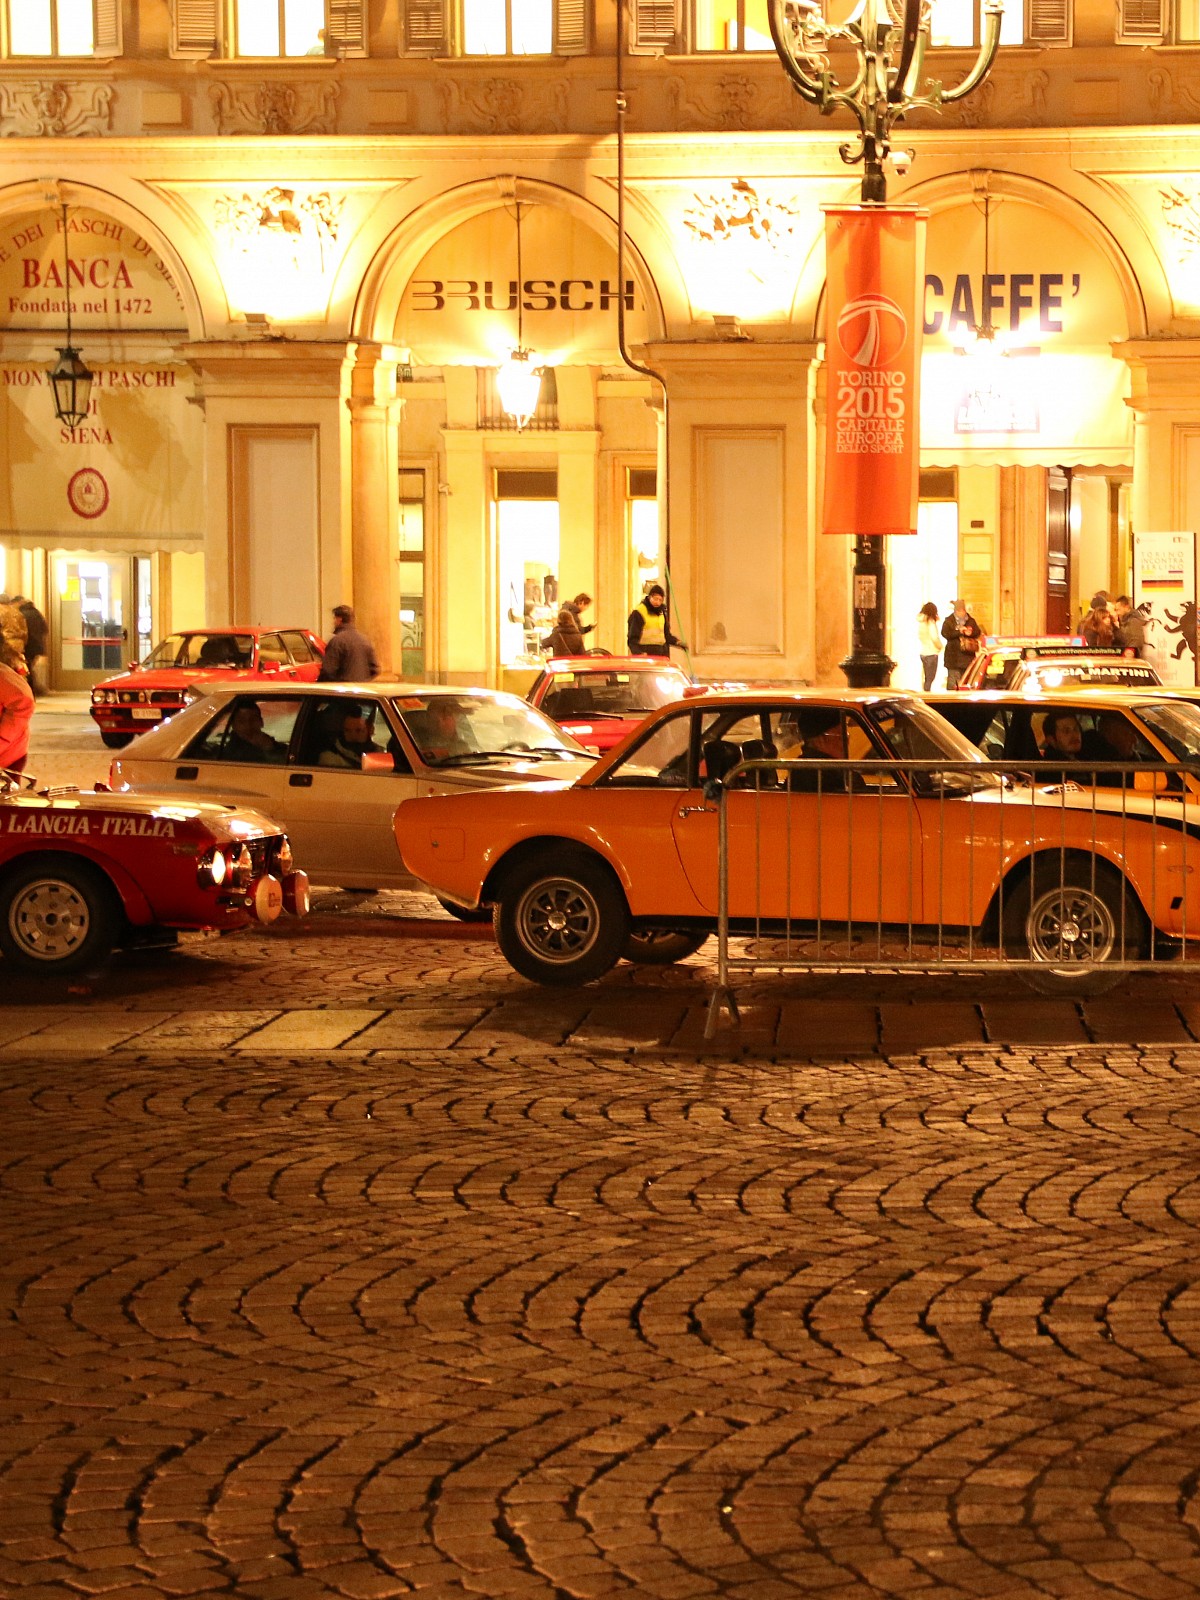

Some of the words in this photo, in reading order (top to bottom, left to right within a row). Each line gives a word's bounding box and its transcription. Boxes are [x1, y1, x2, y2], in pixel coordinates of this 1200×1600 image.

[12, 224, 44, 250] DEI
[56, 218, 125, 241] PASCHI
[22, 258, 134, 289] BANCA
[9, 297, 77, 313] Fondata
[83, 298, 108, 313] nel
[114, 298, 152, 314] 1472
[923, 273, 1080, 335] CAFFE'
[109, 371, 176, 388] PASCHI
[837, 371, 906, 386] TORINO
[837, 387, 905, 419] 2015
[836, 419, 905, 432] CAPITALE
[60, 427, 114, 444] SIENA
[836, 431, 905, 445] EUROPEA
[836, 444, 869, 454] DELLO
[870, 444, 904, 454] SPORT
[1088, 667, 1149, 678] MARTINI
[7, 813, 175, 838] LANCIA-ITALIA
